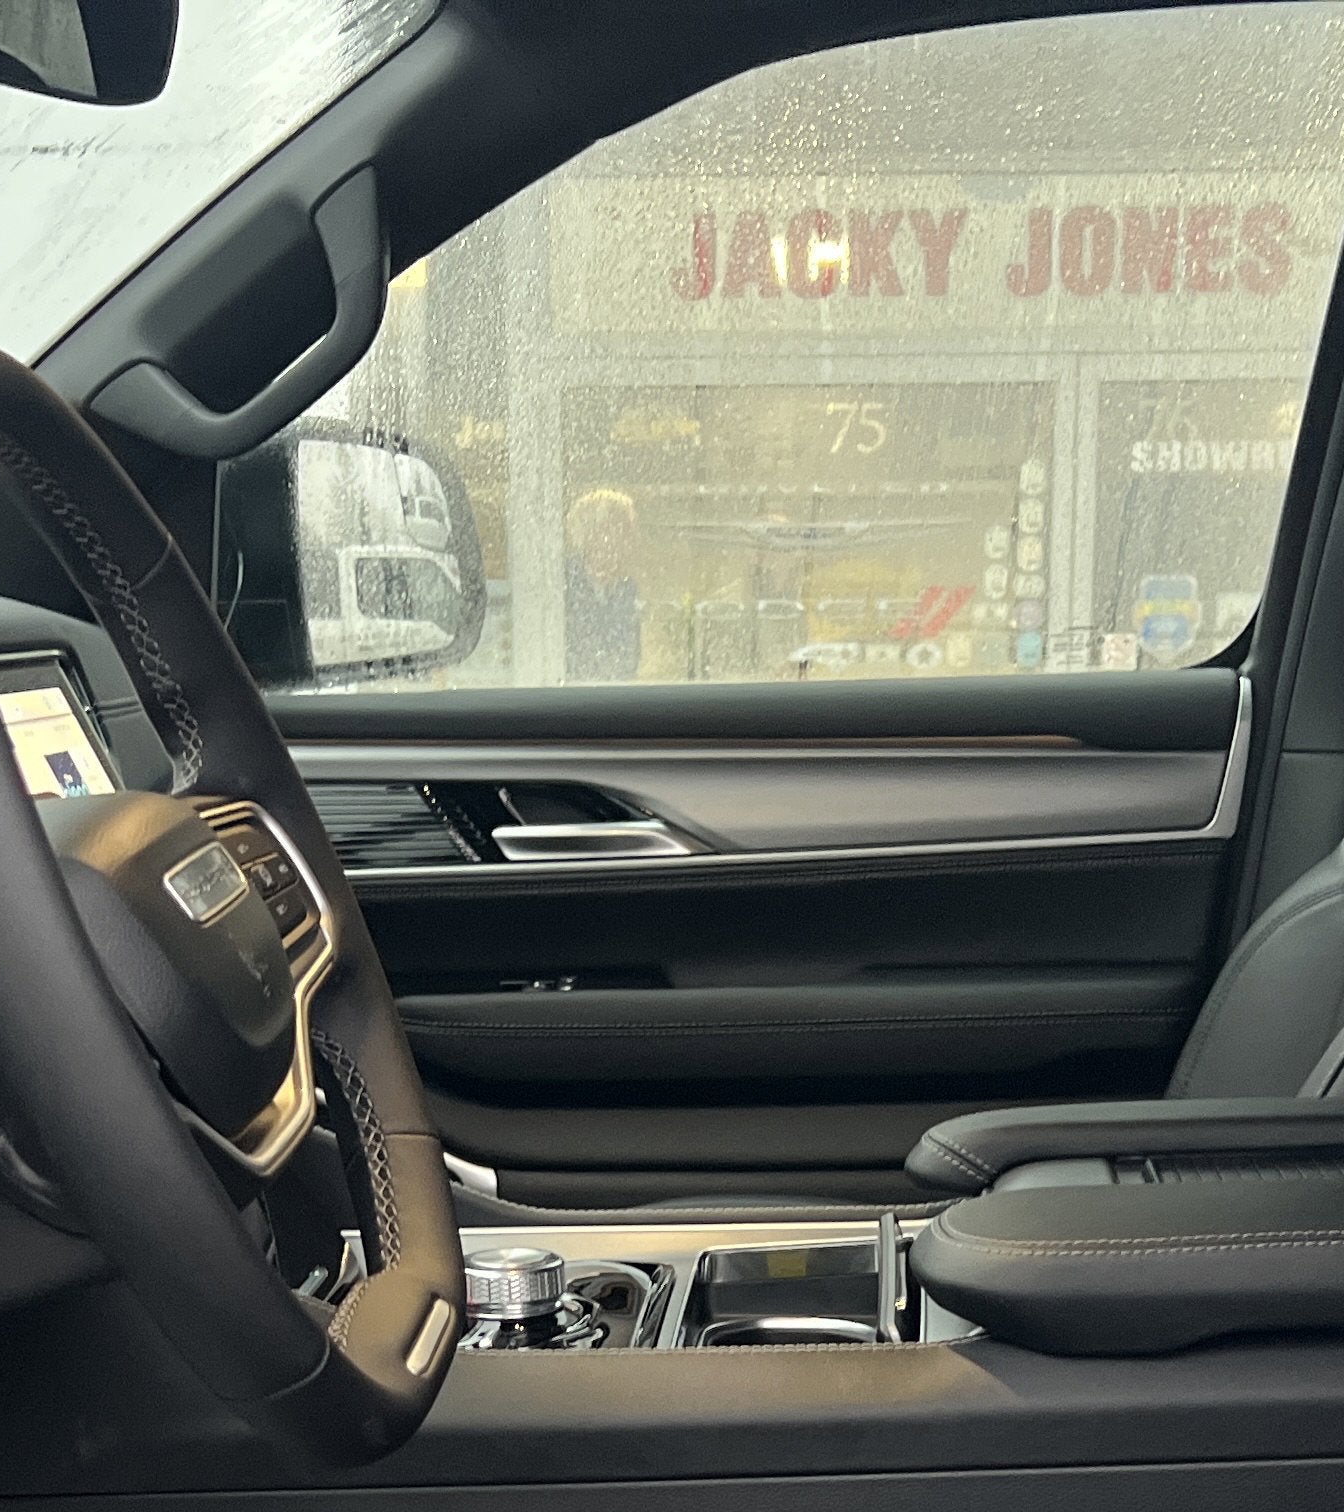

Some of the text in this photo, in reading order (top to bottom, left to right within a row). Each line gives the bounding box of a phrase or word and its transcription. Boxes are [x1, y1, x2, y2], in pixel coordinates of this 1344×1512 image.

[669, 202, 1294, 300] JACKY JONES
[825, 400, 888, 455] 75
